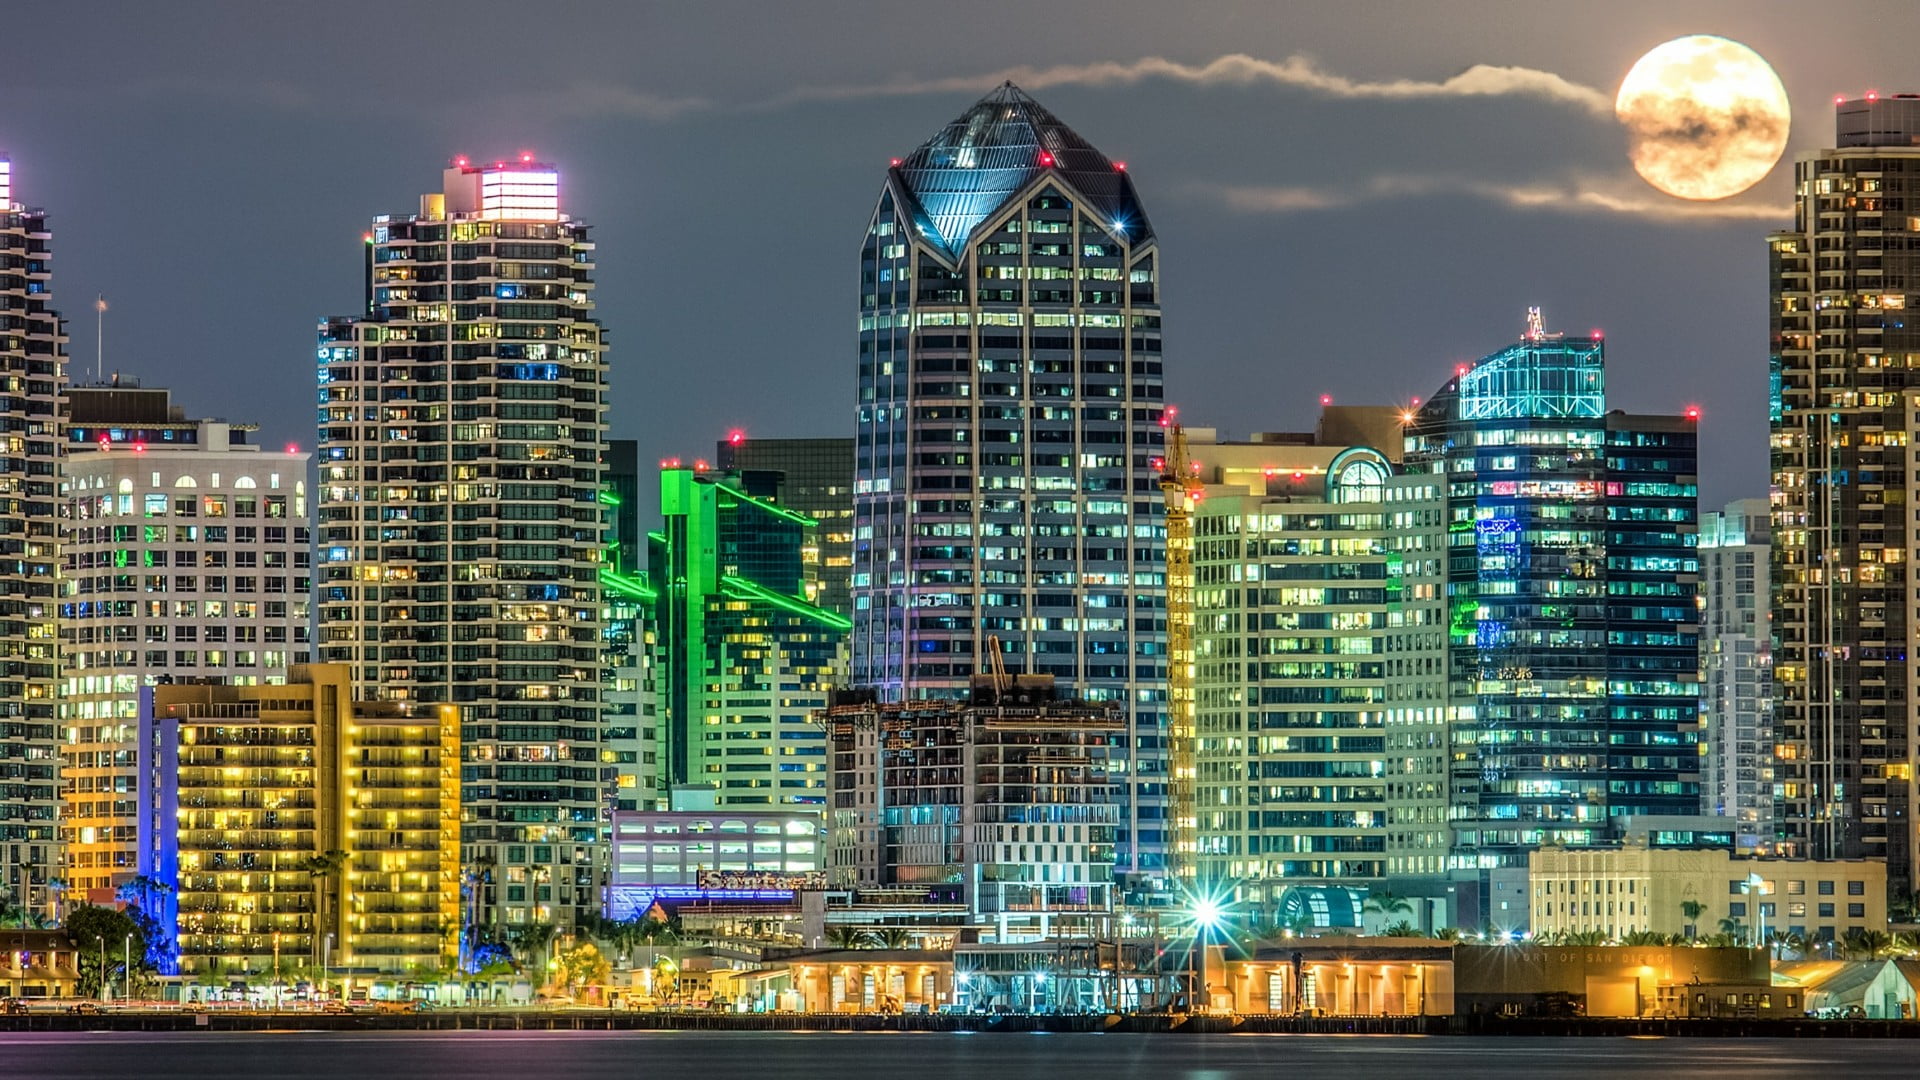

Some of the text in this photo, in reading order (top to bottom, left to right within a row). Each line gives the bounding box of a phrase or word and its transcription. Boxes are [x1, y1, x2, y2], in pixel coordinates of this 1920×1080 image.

[707, 871, 788, 889] Santa
[1513, 953, 1665, 963] PORT OF SAN DIEGO
